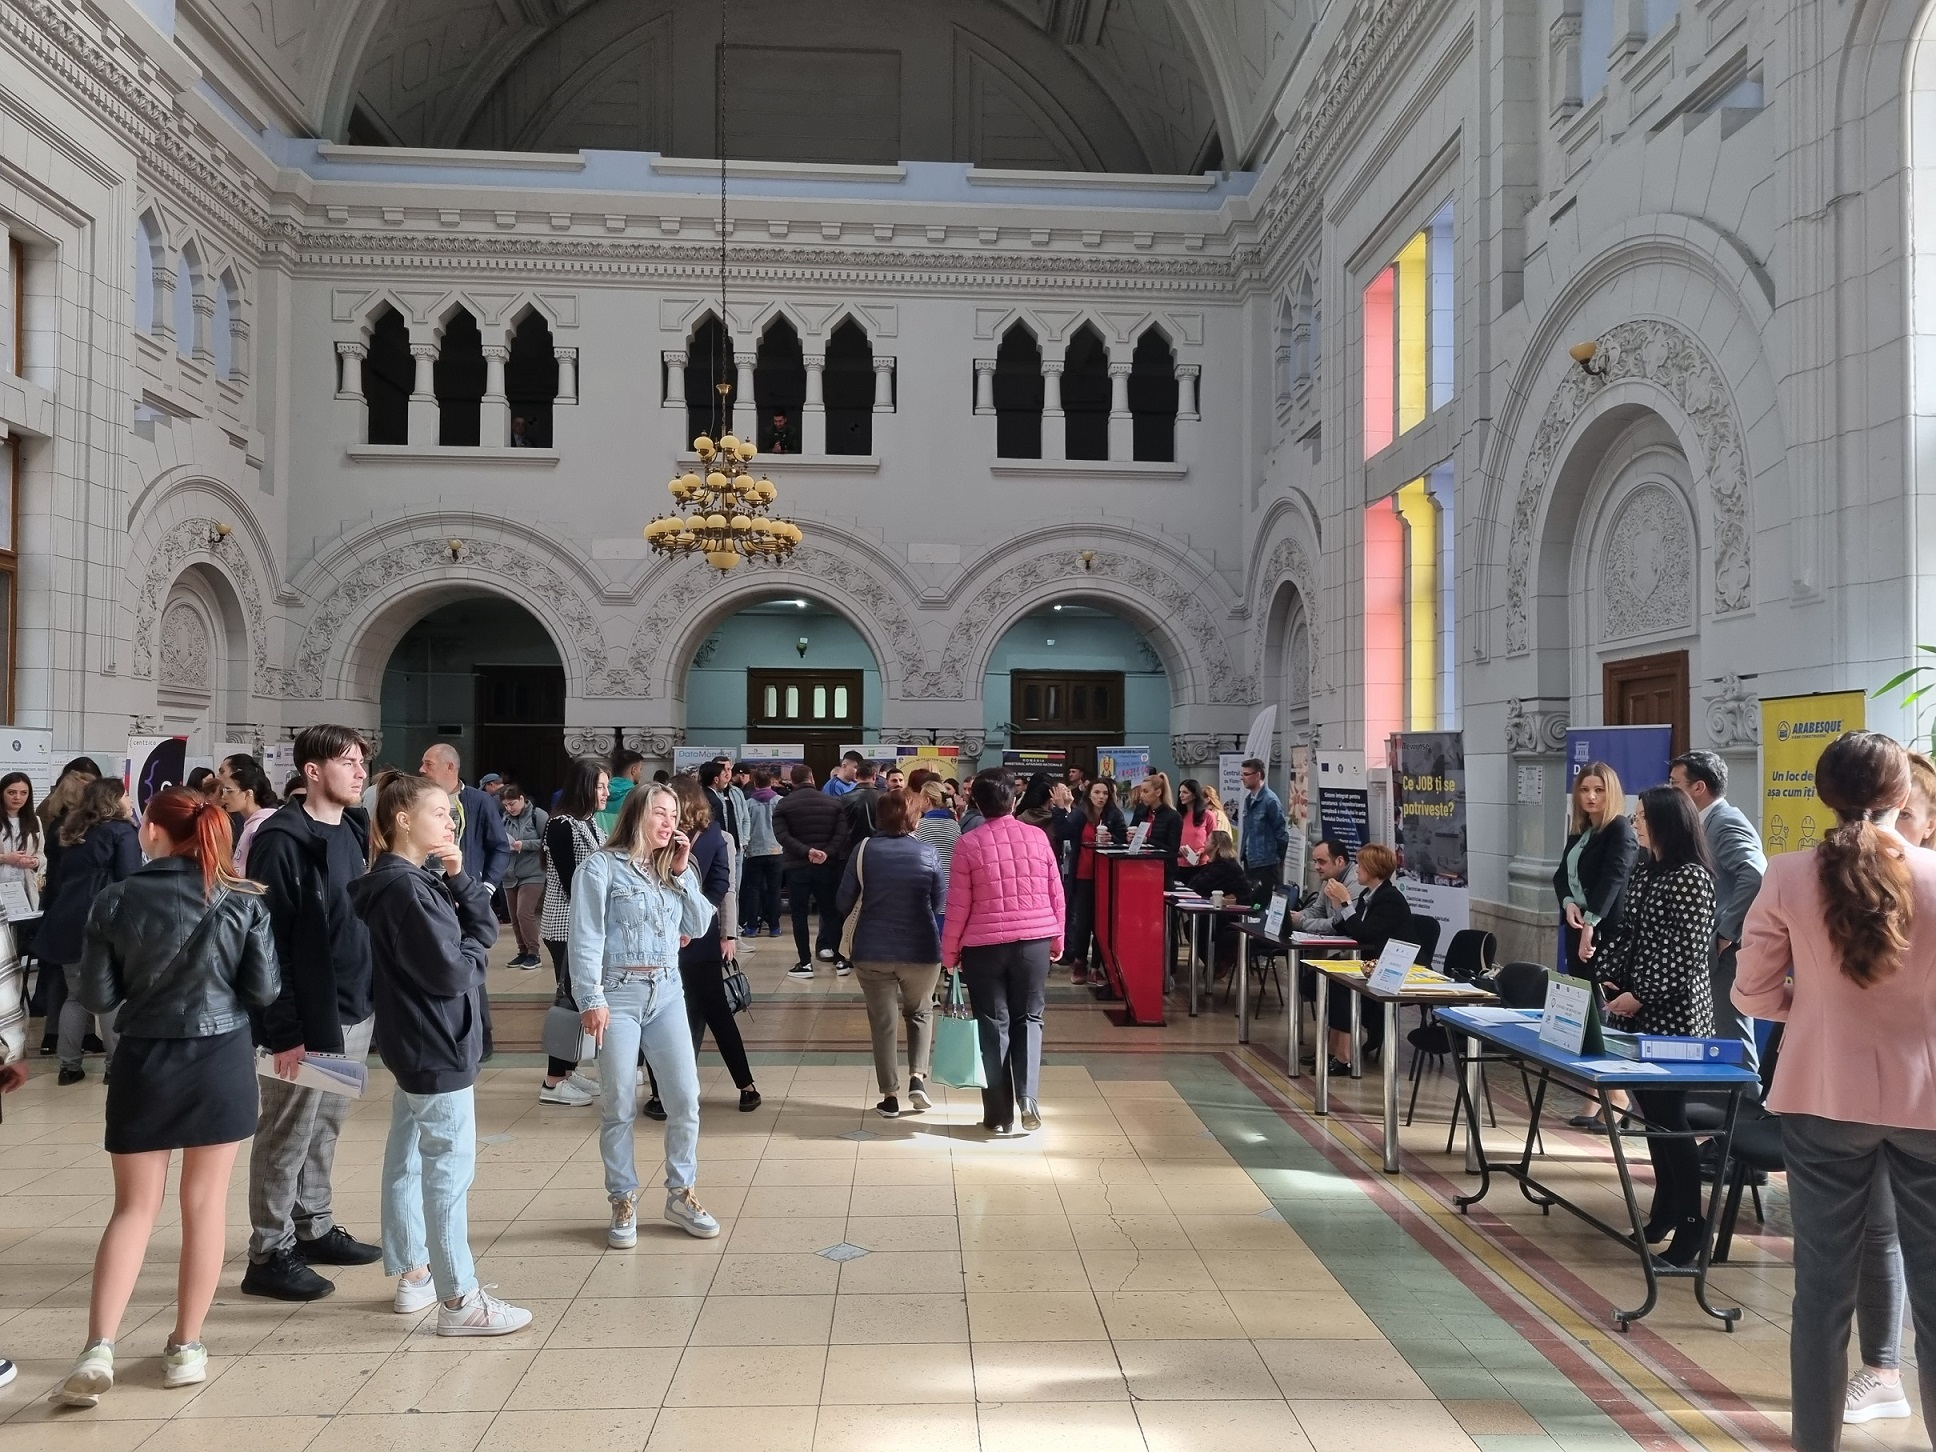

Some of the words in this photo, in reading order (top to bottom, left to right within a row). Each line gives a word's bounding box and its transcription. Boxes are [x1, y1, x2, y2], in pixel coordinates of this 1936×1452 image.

[1792, 720, 1842, 734] ARABESQUE
[1772, 770, 1784, 782] Un
[1786, 770, 1799, 782] loc
[1801, 770, 1814, 782] de
[1402, 775, 1414, 791] Ce
[1415, 775, 1433, 791] JOB
[1435, 775, 1442, 794] ți
[1443, 779, 1456, 792] se
[1767, 788, 1781, 800] așa
[1782, 788, 1802, 798] cum
[1403, 801, 1455, 819] potrivește?
